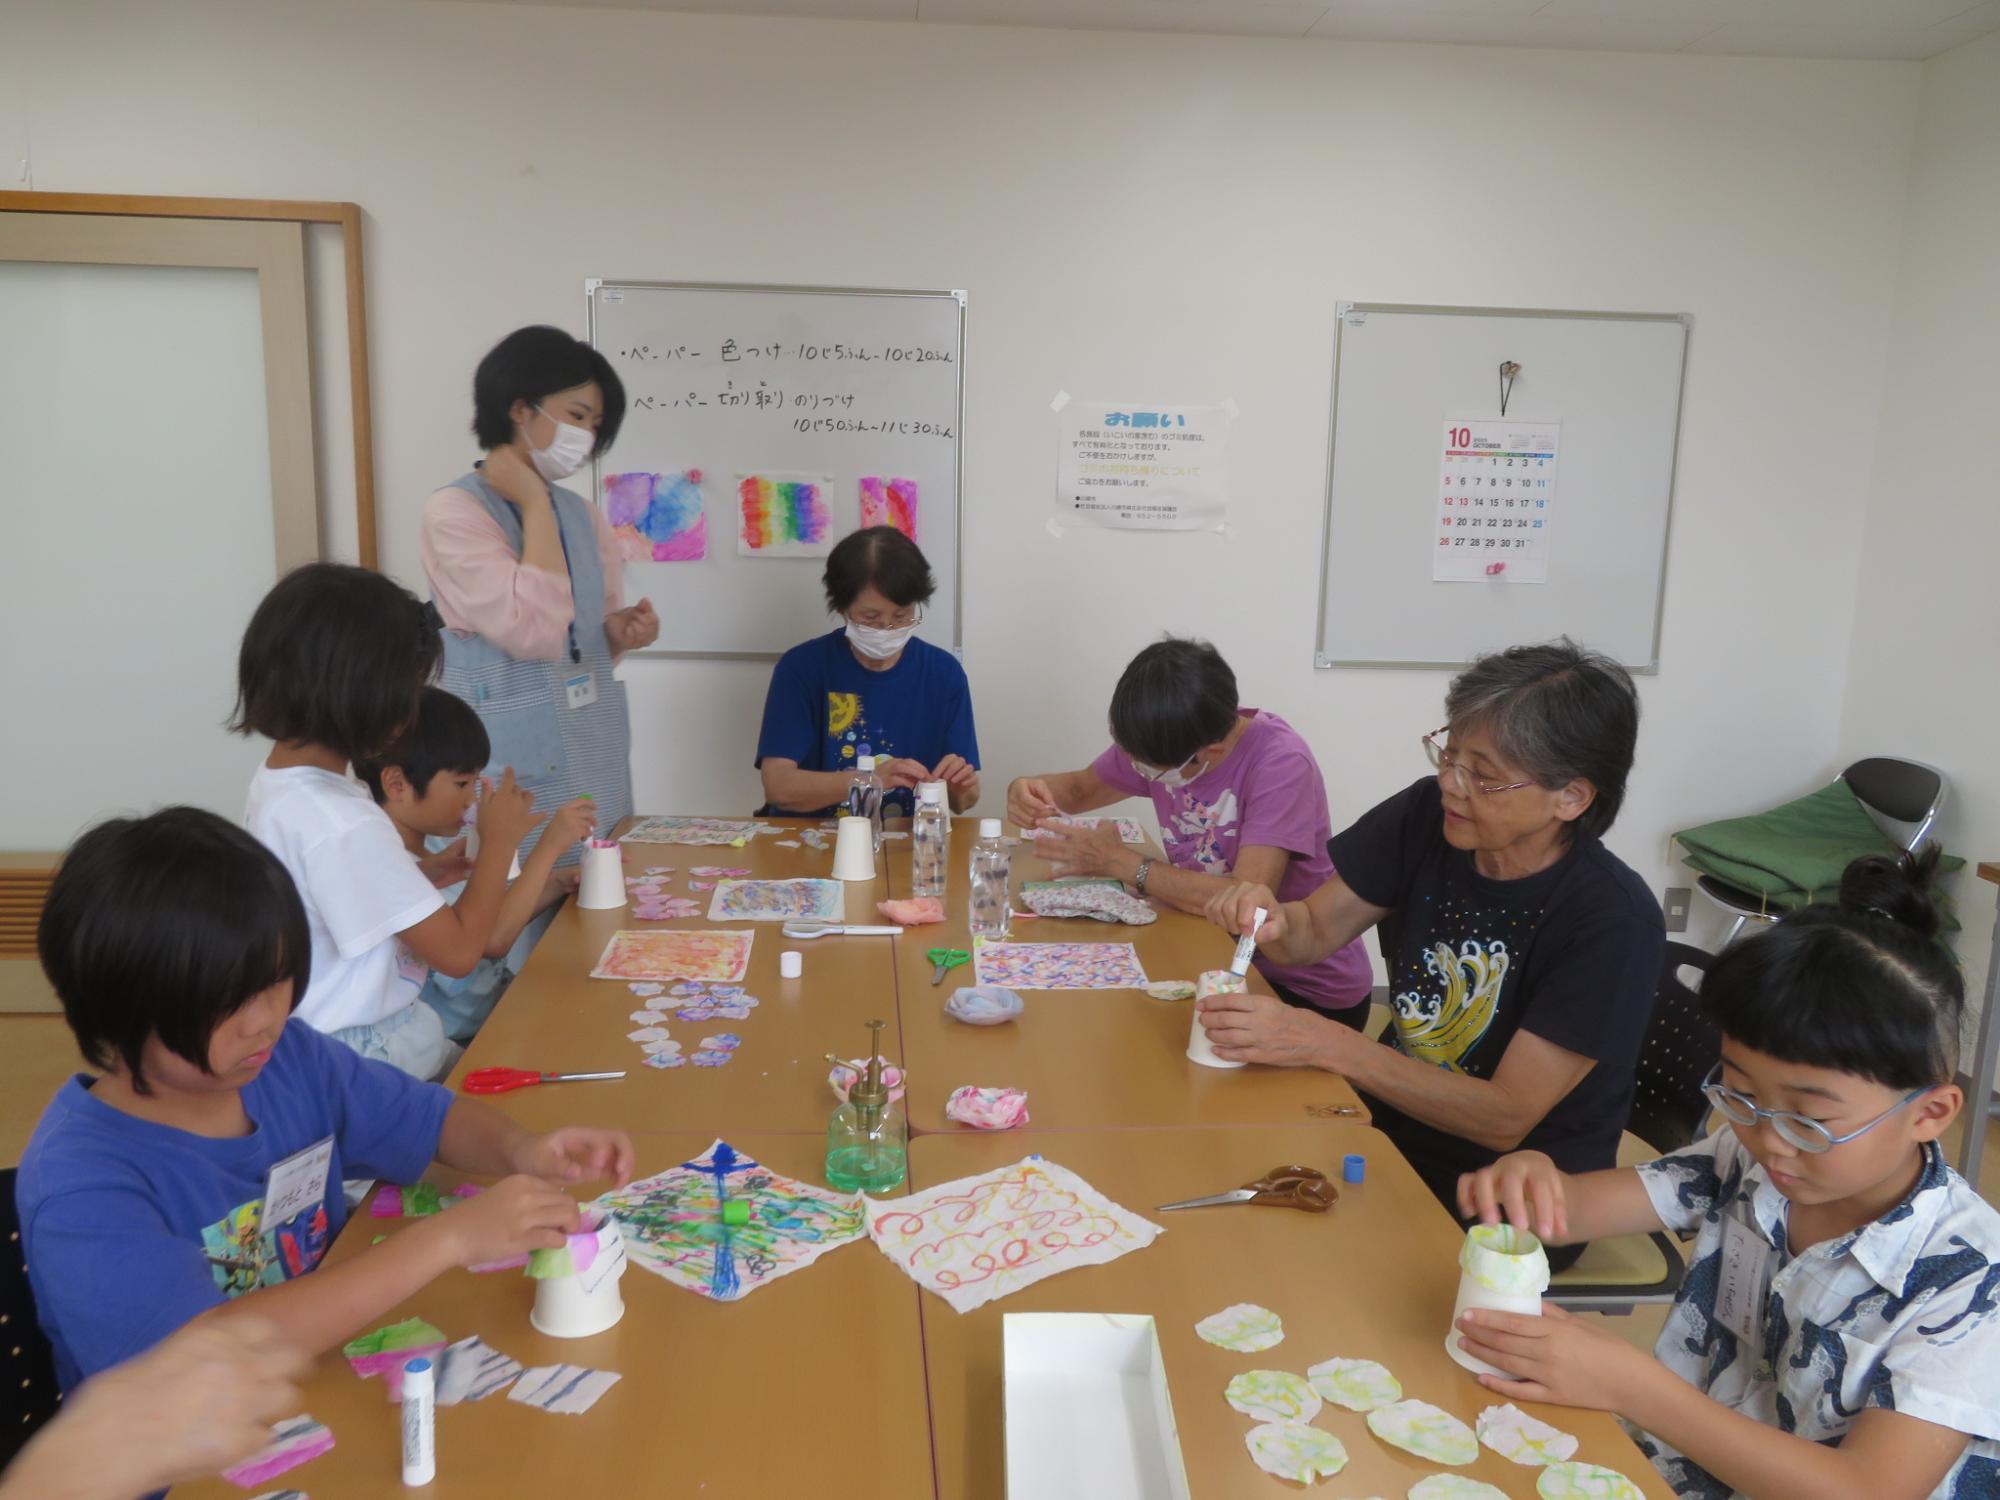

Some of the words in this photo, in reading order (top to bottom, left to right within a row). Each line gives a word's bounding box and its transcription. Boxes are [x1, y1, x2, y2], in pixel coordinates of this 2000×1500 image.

[634, 392, 708, 410] ペーパー
[794, 393, 855, 410] のりづけ
[1104, 412, 1185, 428] お願い
[1449, 428, 1471, 448] 10
[1445, 477, 1451, 485] 5
[1475, 478, 1481, 486] 7
[1491, 478, 1496, 486] 8
[1444, 498, 1453, 506] 12
[1460, 498, 1468, 506] 13
[1475, 499, 1483, 507] 14
[1490, 499, 1498, 507] 15
[1505, 499, 1514, 507] 16
[1520, 500, 1529, 508] 17
[1536, 500, 1544, 508] 18
[1457, 518, 1467, 526] 20
[1487, 519, 1497, 527] 22
[1518, 520, 1527, 528] 24
[1532, 520, 1542, 528] 25
[1440, 538, 1450, 546] 26
[1455, 538, 1465, 546] 27
[1470, 538, 1480, 547] 28
[1485, 539, 1495, 547] 29
[1500, 539, 1510, 547] 30
[1515, 539, 1524, 548] 31
